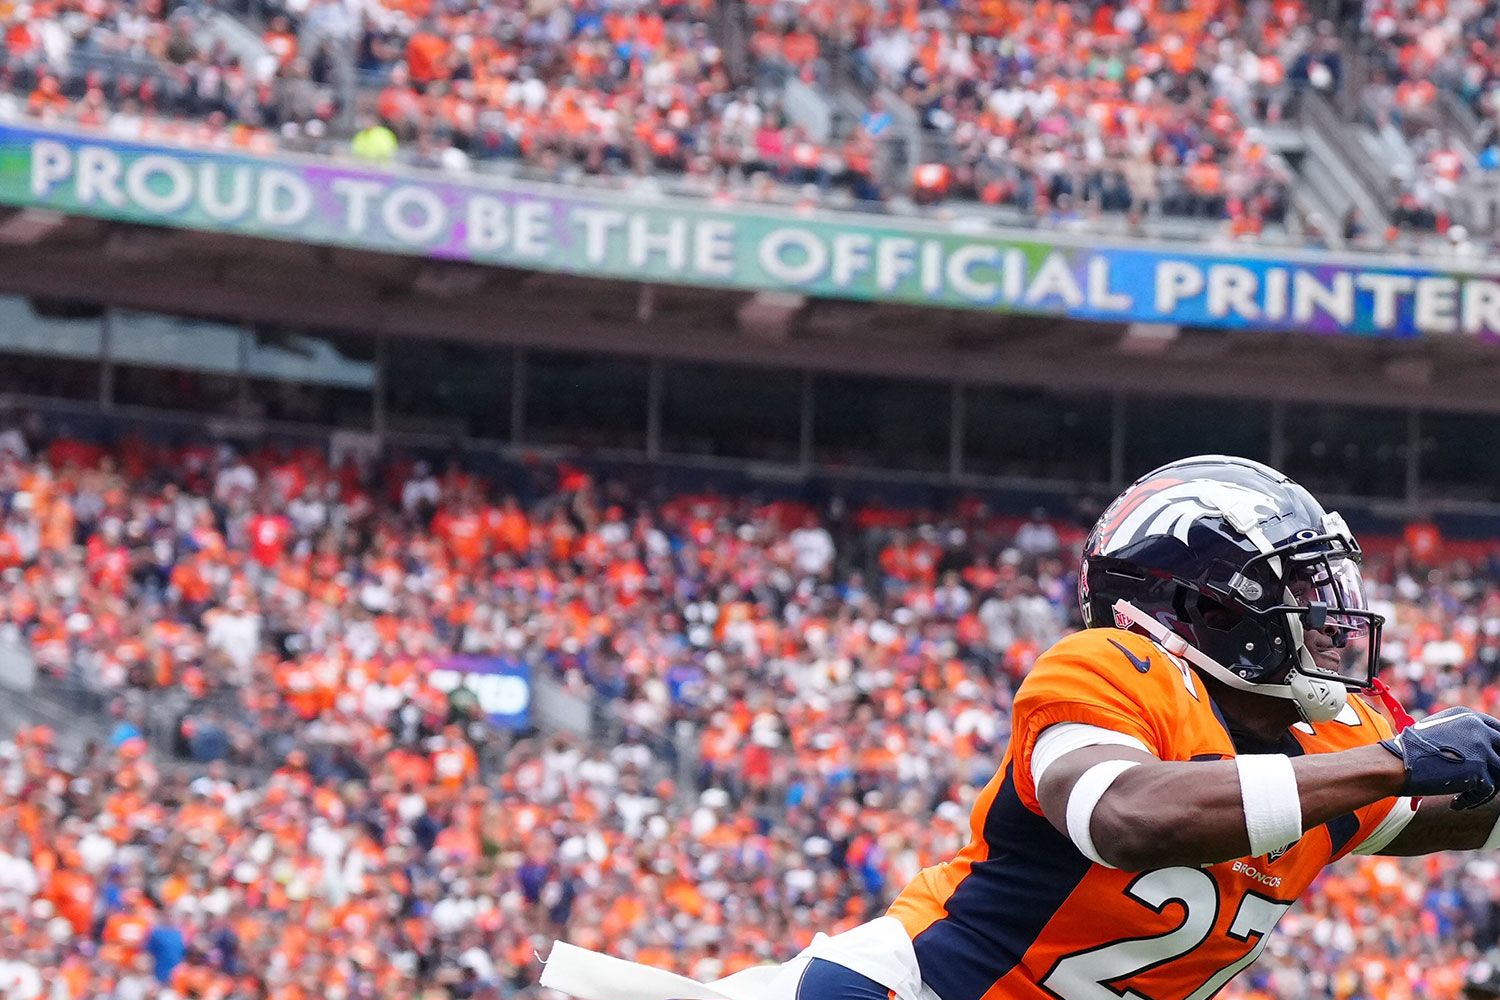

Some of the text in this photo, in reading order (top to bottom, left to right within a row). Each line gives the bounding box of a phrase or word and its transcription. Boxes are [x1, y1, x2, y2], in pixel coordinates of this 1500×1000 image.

[30, 139, 312, 226] PROUD
[332, 177, 446, 243] TO
[467, 196, 550, 257] BE
[575, 210, 736, 277] THE
[757, 226, 1133, 312] OFFICIAL
[1232, 861, 1281, 888] BRONCOS
